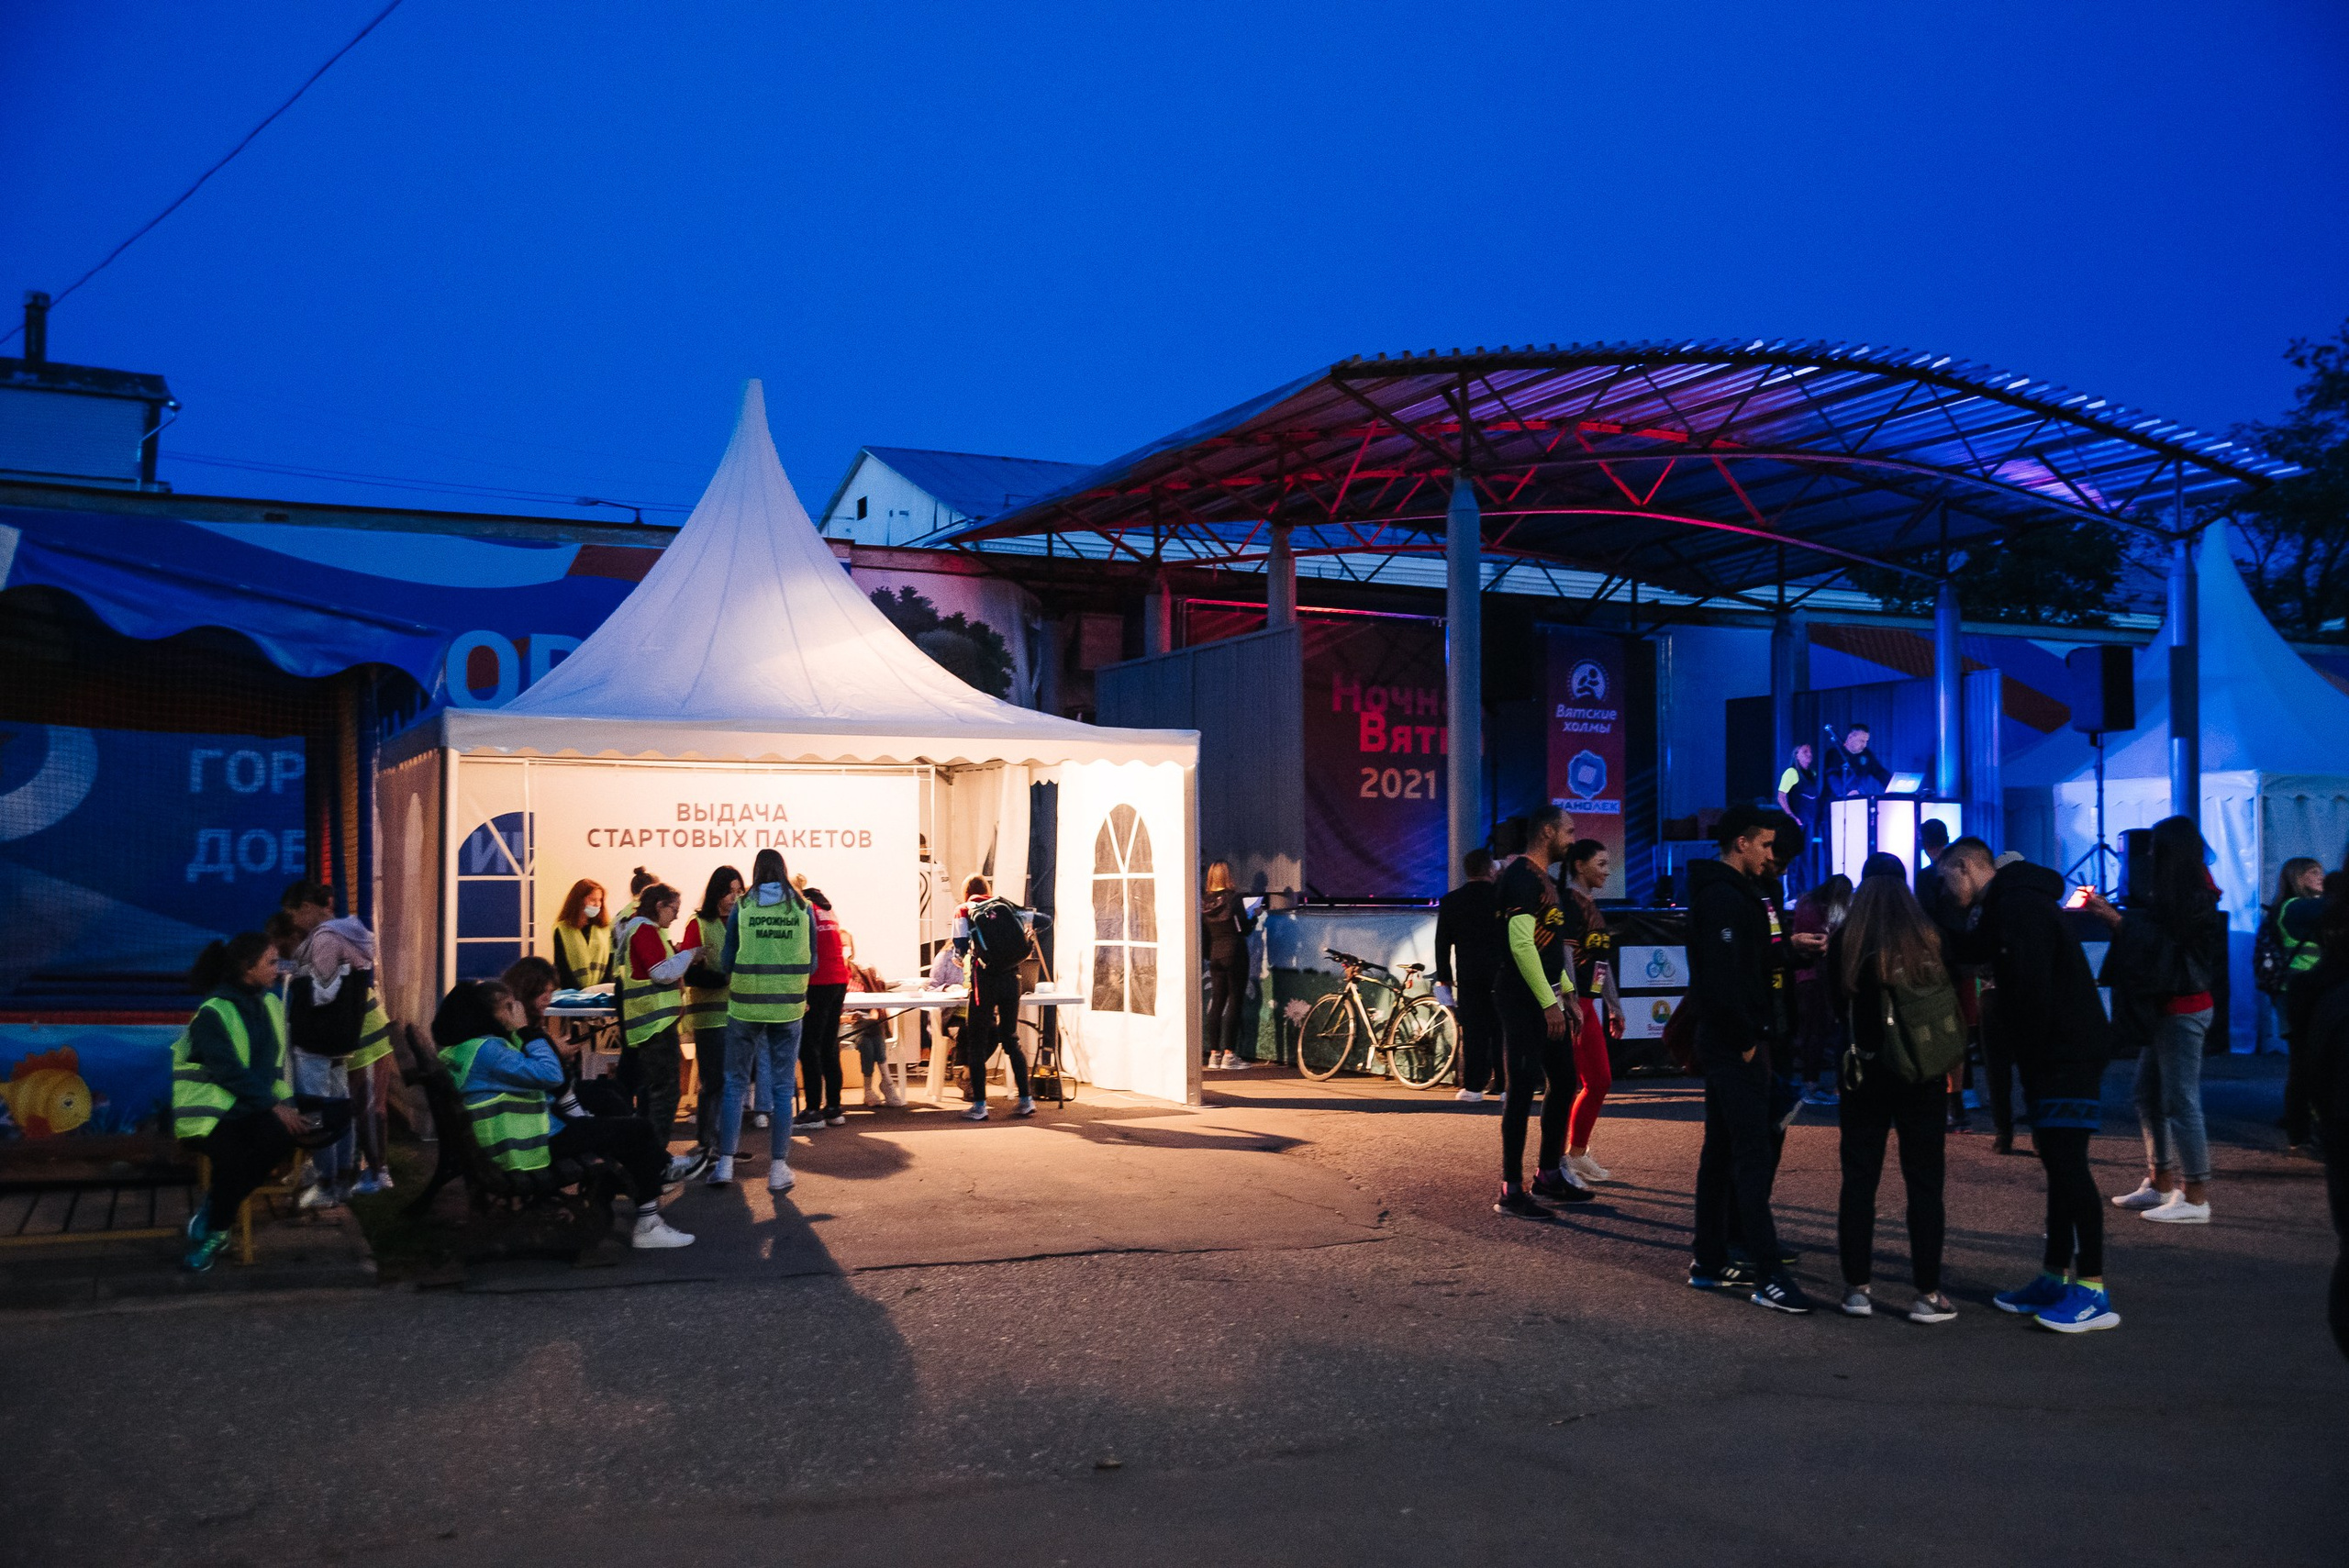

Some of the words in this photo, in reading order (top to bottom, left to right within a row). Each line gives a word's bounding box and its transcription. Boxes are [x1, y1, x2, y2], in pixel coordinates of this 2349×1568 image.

[1332, 672, 1486, 717] Ночн
[1556, 704, 1617, 720] Вятские
[1360, 712, 1485, 756] Вят
[1563, 721, 1611, 733] холмы
[1360, 767, 1436, 799] 2021
[676, 803, 788, 826] ВЫДАЧА
[587, 828, 747, 848] СТАРТОВЫХ
[756, 828, 872, 848] ПАКЕТОВ
[749, 916, 799, 927] ДОРОЖНЫЙ
